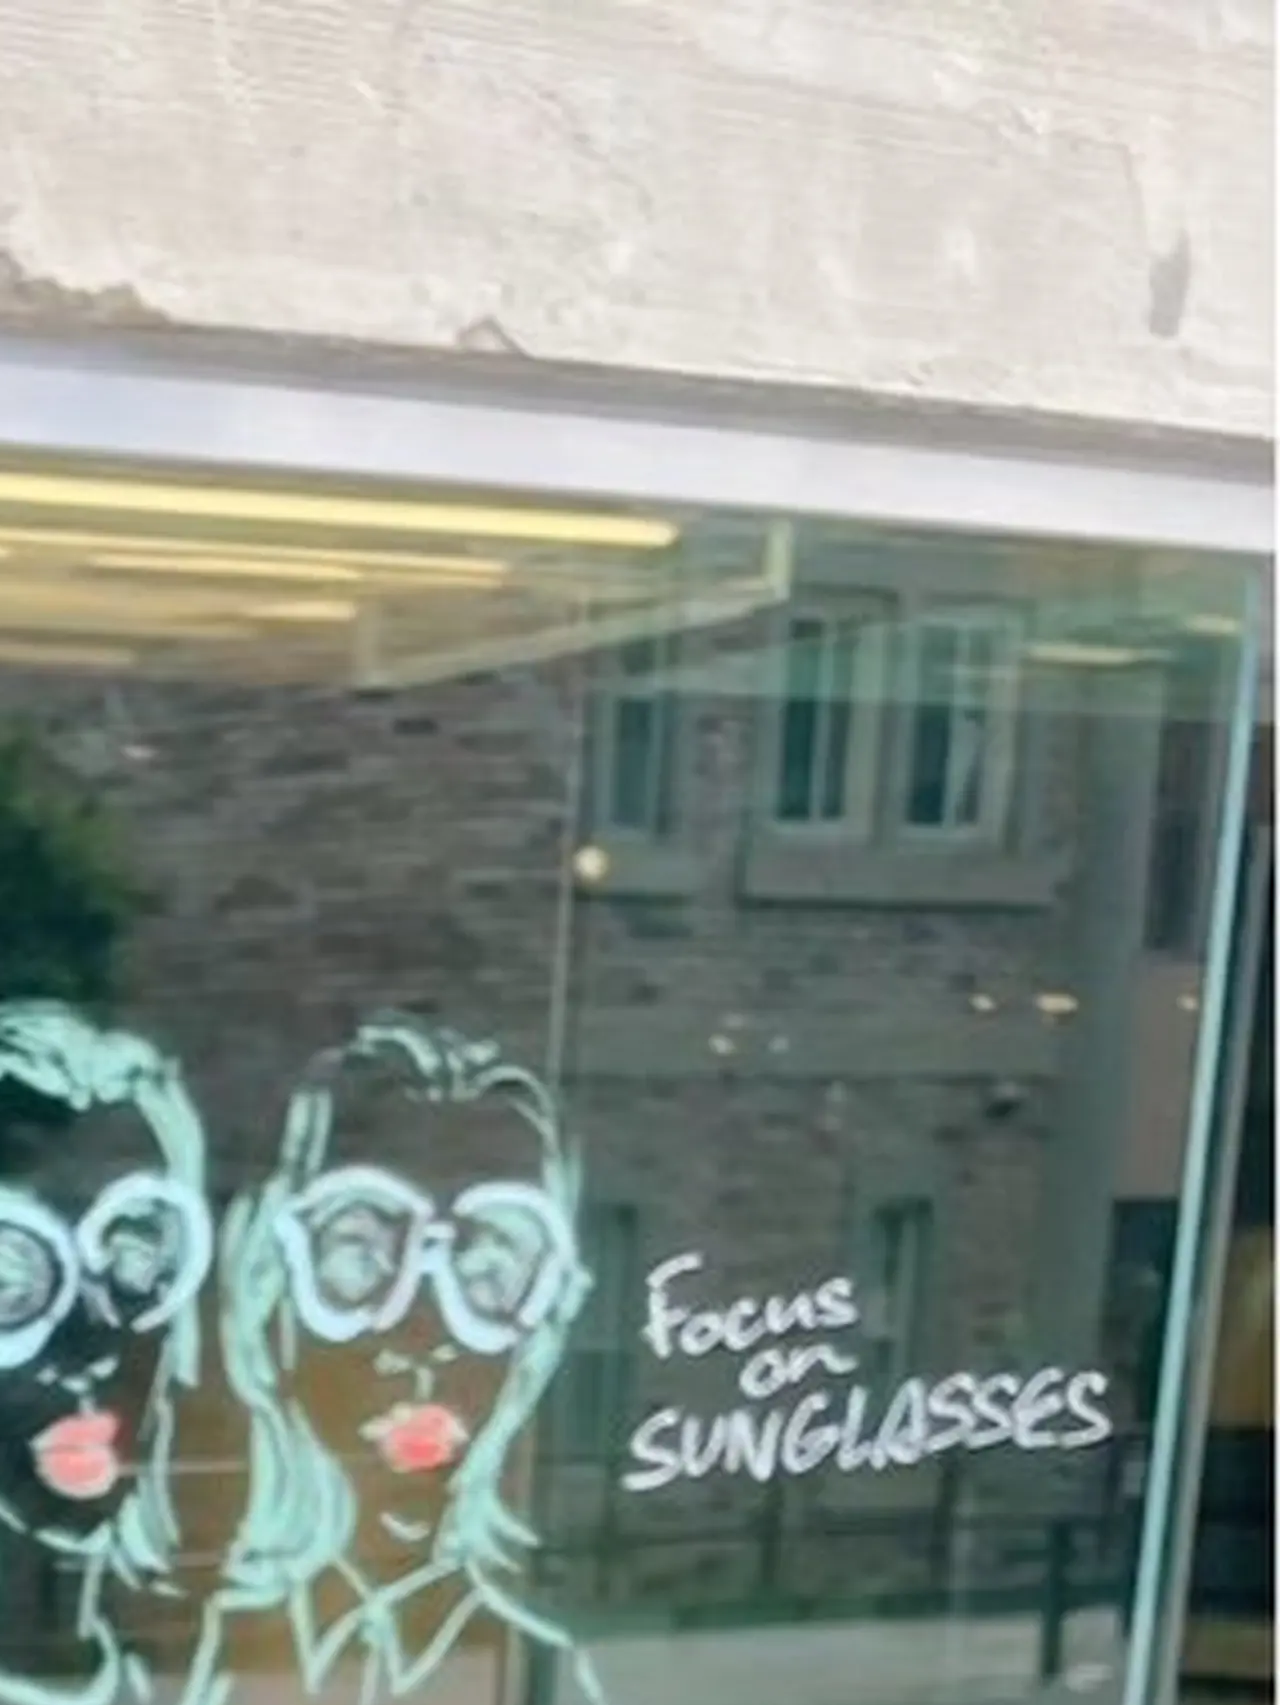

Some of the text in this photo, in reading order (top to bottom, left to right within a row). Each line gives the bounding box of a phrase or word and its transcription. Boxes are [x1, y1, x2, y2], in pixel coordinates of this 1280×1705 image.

[643, 1252, 858, 1359] Focus
[739, 1345, 858, 1398] on
[622, 1369, 1111, 1491] SUNGLASSES
